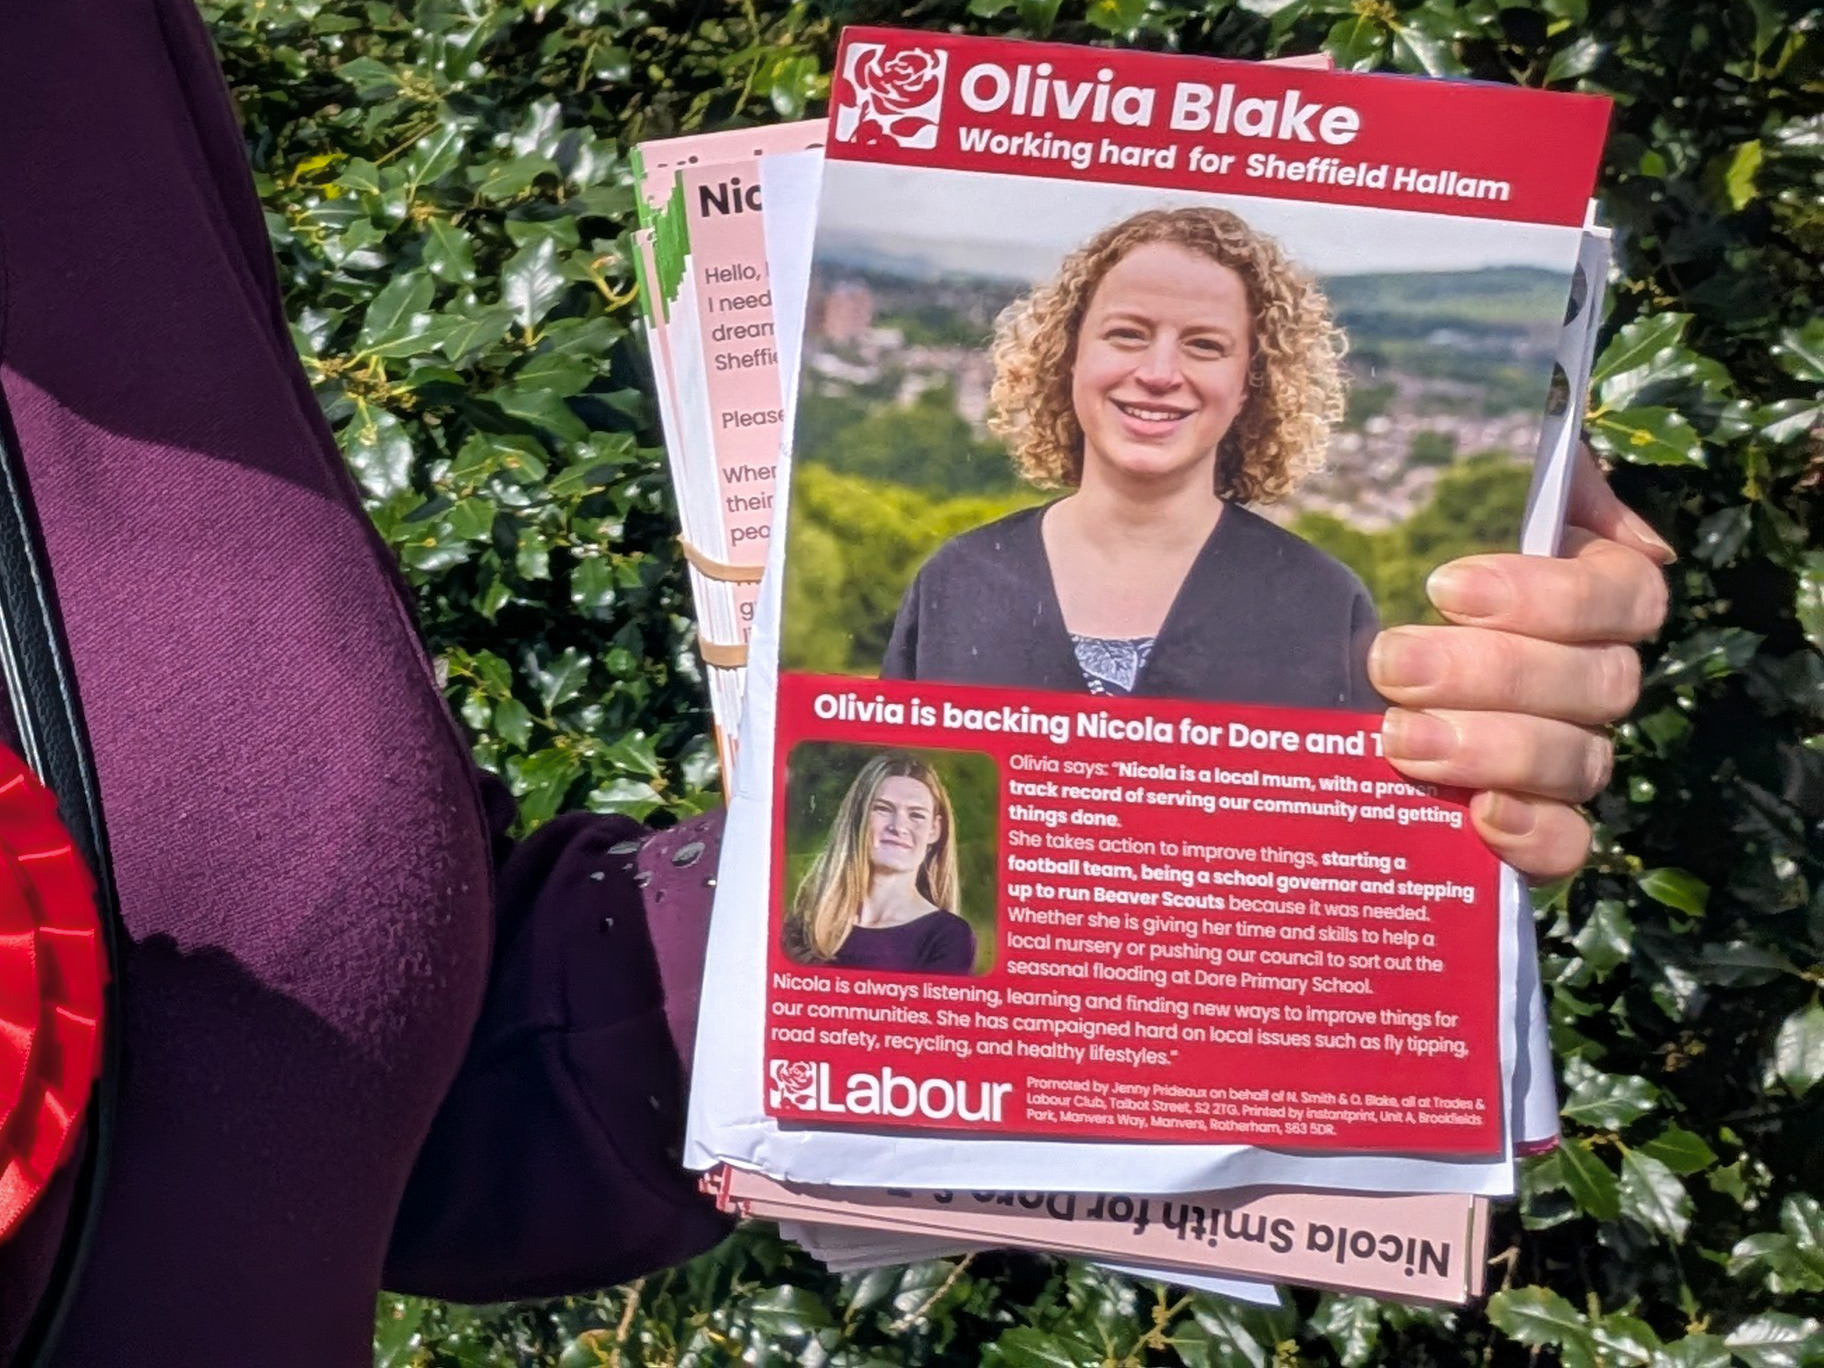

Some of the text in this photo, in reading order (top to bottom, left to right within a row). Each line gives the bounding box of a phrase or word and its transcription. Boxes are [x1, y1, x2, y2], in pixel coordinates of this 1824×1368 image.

[960, 63, 1361, 145] Olivia Blake
[959, 126, 1510, 201] Working hard for Sheffield Hallam
[705, 263, 762, 284] Hello,
[708, 289, 773, 313] I need
[814, 693, 905, 725] Olivia
[910, 697, 937, 727] is
[942, 702, 1070, 744] backing
[1076, 710, 1174, 743] Nicola
[1179, 717, 1223, 746] for
[1228, 722, 1300, 752] Dore
[1305, 730, 1365, 756] and
[1010, 754, 1059, 772] Olivia
[1064, 761, 1109, 780] says:
[1180, 764, 1196, 782] is
[1198, 769, 1212, 783] a
[1214, 767, 1260, 786] local
[1262, 773, 1316, 792] mum,
[1319, 775, 1358, 793] with
[1360, 780, 1373, 794] a
[1008, 804, 1121, 828] things done.
[1009, 779, 1463, 828] track record of serving our community and getting
[1009, 829, 1406, 874] She takes action to improve things, starting a
[1008, 854, 1475, 903] football team, being a school governor and stepping
[1007, 883, 1430, 921] up to run Beaver Scouts because it was needed.
[1007, 906, 1435, 950] Whether she is giving her time and skills to help a
[1007, 931, 1444, 972] local nursery or pushing our council to sort out the
[1007, 960, 1373, 996] seasonal flooding at Dore Primary School.
[773, 972, 1459, 1032] Nicola is always listening, learning and finding new ways to improve things for
[771, 1001, 1469, 1059] our communities. She has campaigned hard on local issues such as fly tipping,
[771, 1026, 815, 1043] road
[819, 1028, 880, 1052] safety,
[884, 1034, 972, 1058] recycling,
[976, 1039, 1013, 1056] and
[1017, 1039, 1085, 1065] healthy
[820, 1061, 1012, 1123] Labour
[1087, 1192, 1149, 1235] for
[1162, 1201, 1296, 1254] Smith
[1306, 1222, 1451, 1278] Nicola
